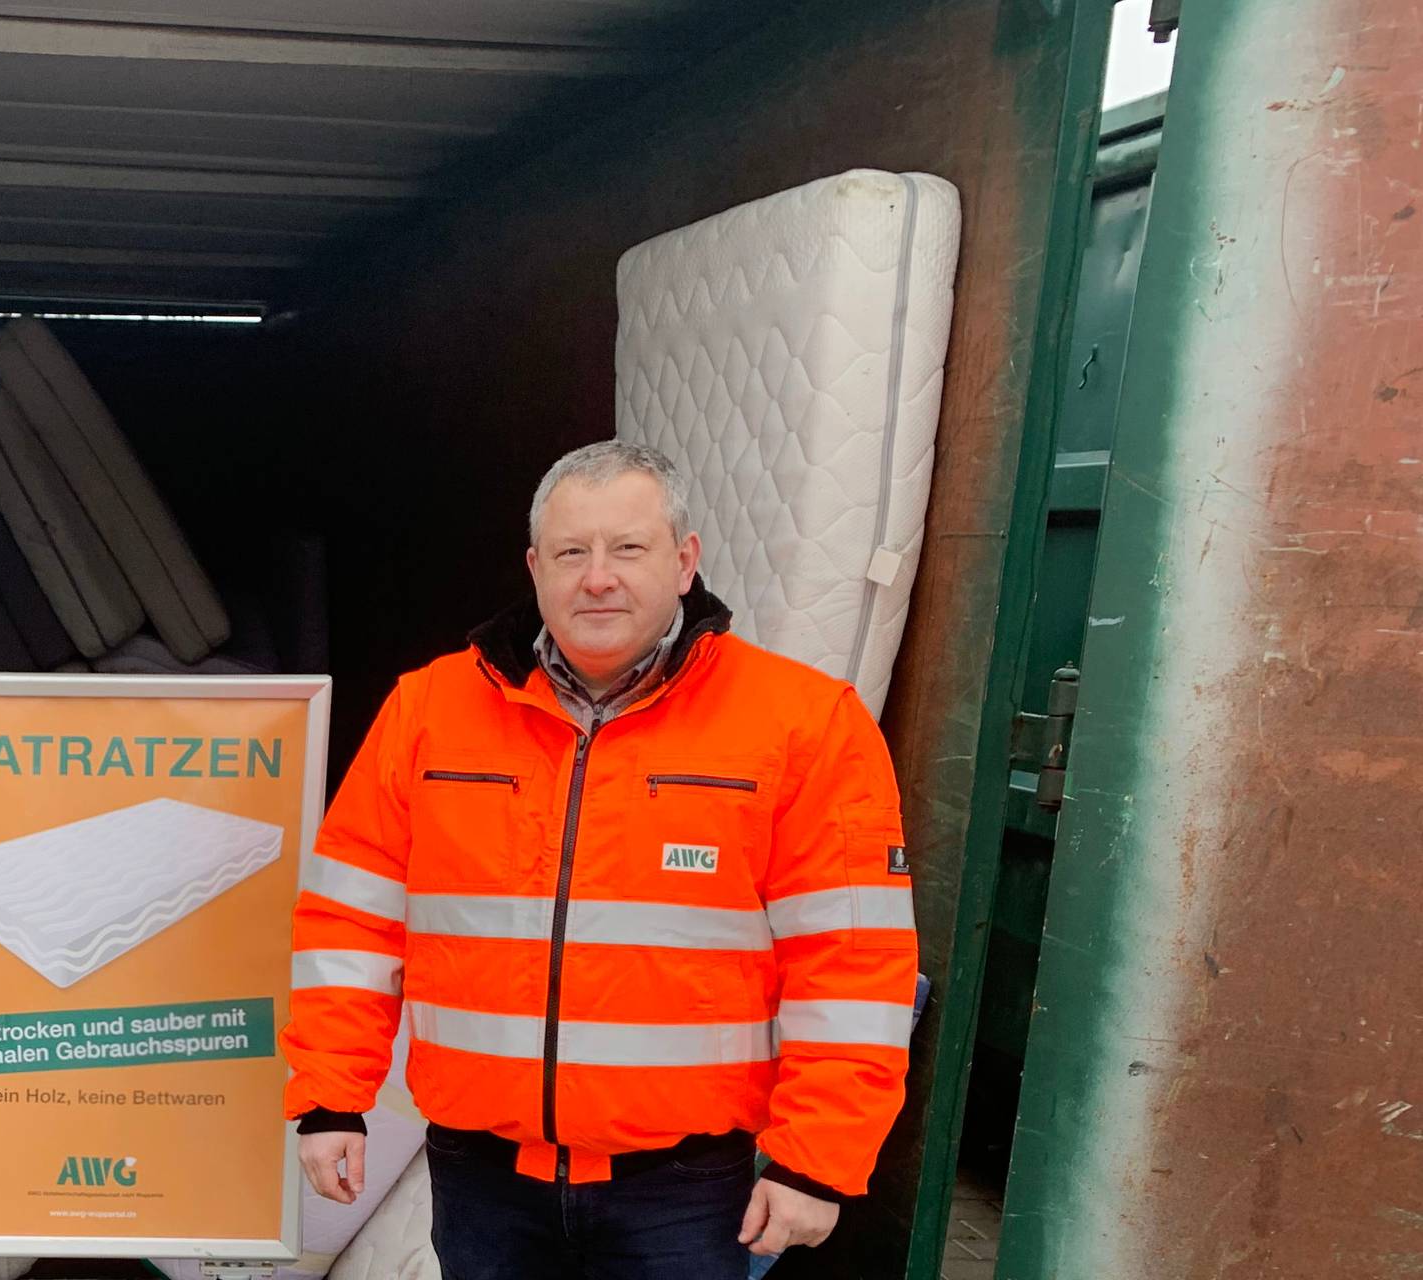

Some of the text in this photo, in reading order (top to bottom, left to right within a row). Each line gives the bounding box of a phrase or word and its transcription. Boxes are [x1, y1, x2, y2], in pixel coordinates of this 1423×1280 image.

[665, 847, 715, 868] AWG
[83, 1016, 124, 1036] und
[130, 1012, 205, 1034] sauber
[211, 1008, 247, 1028] mit
[55, 1033, 249, 1061] Gebrauchsspuren
[26, 1088, 72, 1106] Holz,
[77, 1090, 127, 1105] keine
[132, 1090, 226, 1106] Bettwaren
[56, 1156, 138, 1187] AWG
